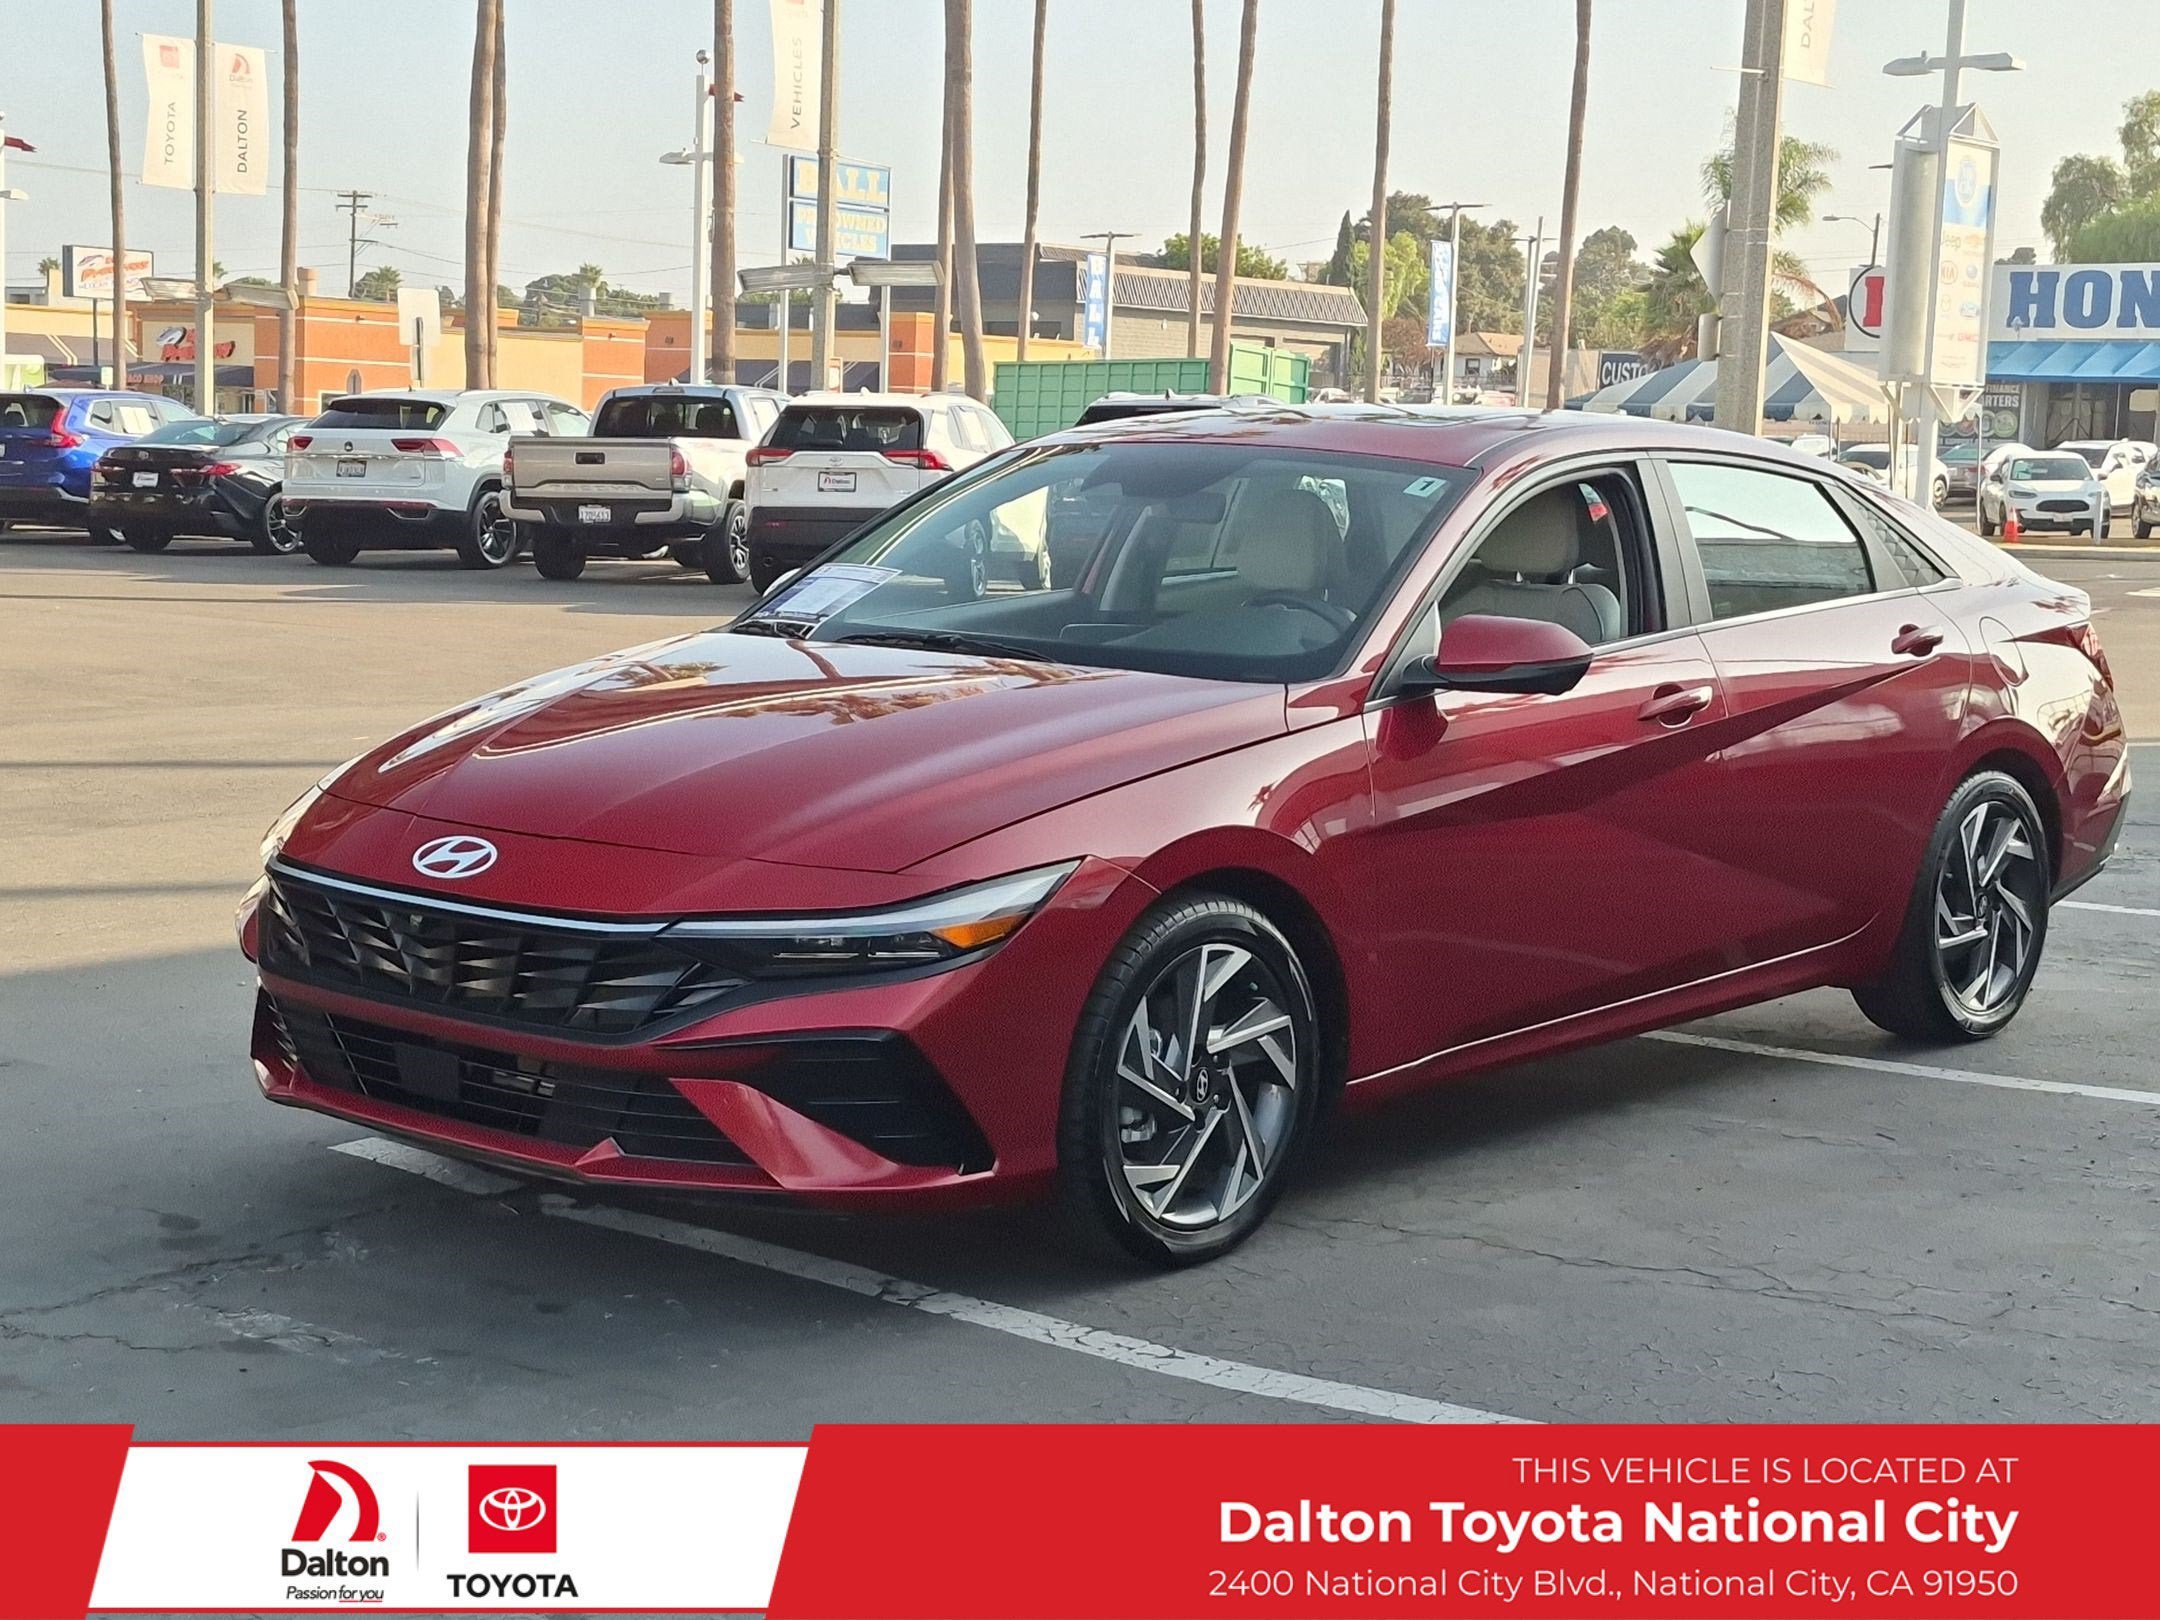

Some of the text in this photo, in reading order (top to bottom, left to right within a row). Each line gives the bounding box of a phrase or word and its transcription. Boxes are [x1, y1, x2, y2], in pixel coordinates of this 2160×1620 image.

[790, 37, 803, 129] VEHICLES
[164, 101, 177, 166] TOYOTA
[237, 109, 248, 173] DALTON
[126, 373, 143, 384] ACO
